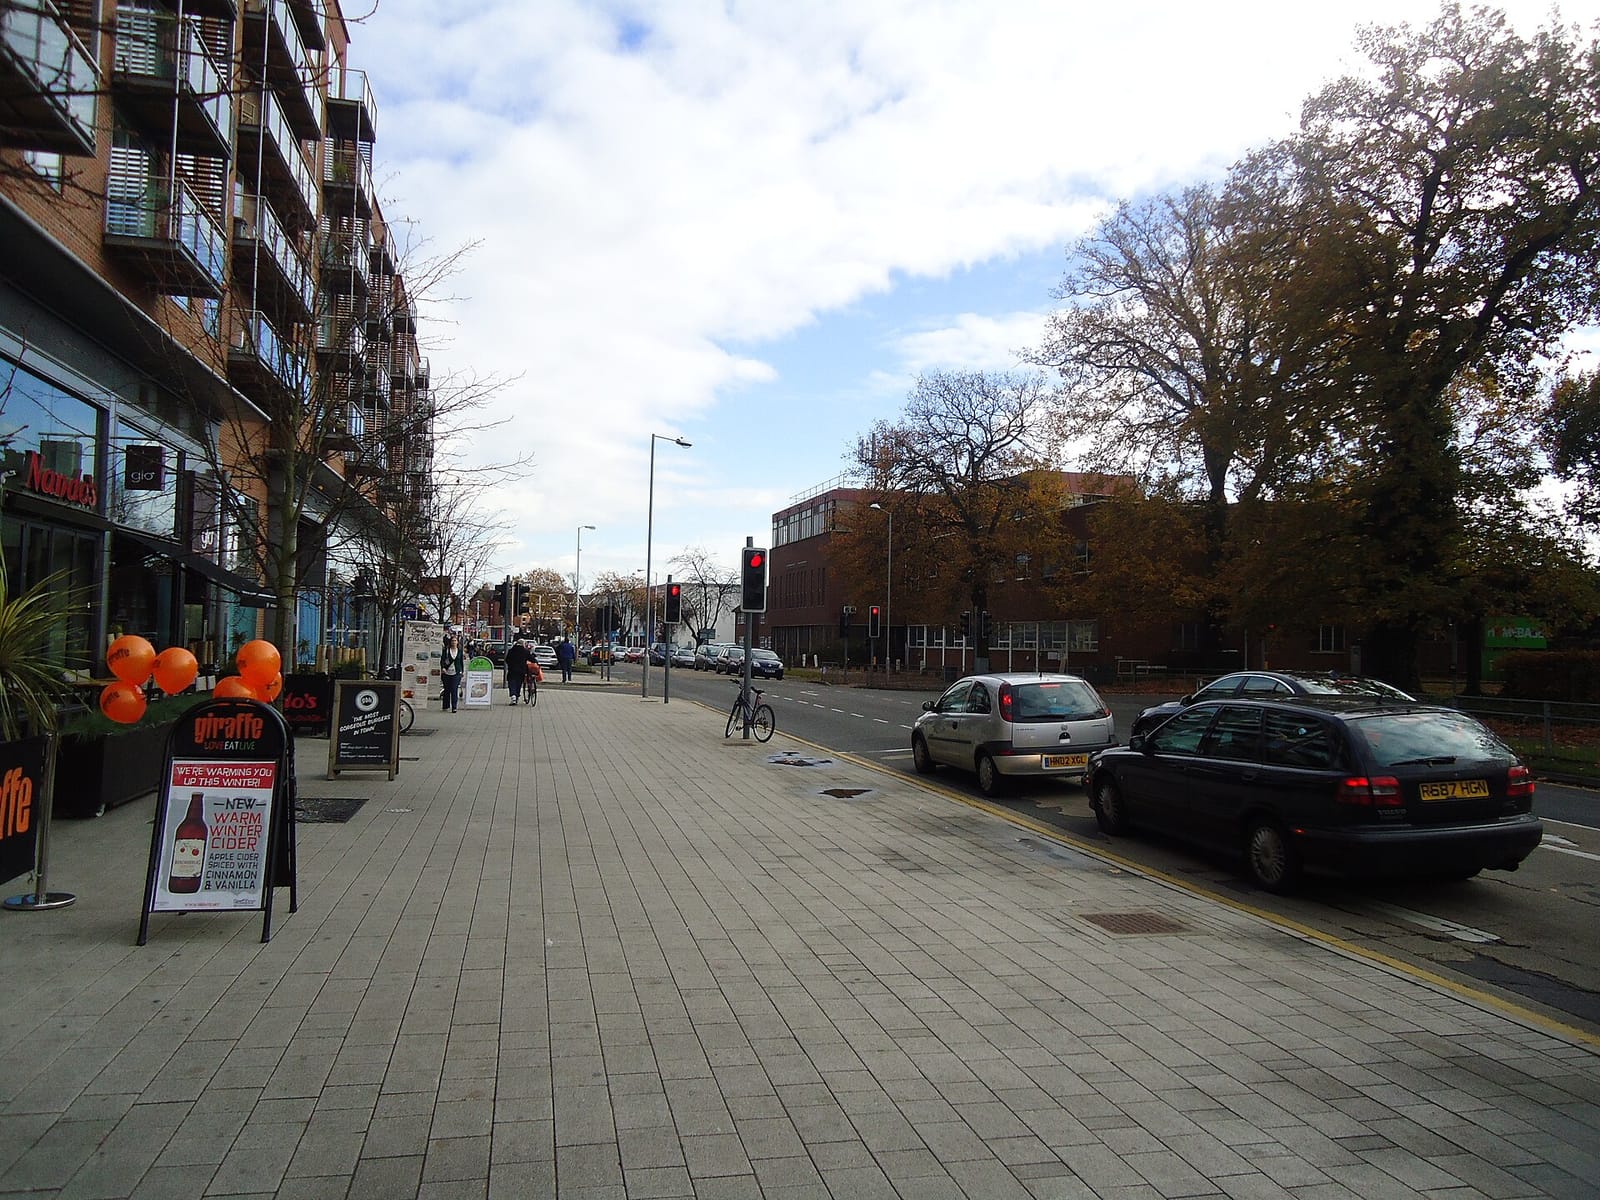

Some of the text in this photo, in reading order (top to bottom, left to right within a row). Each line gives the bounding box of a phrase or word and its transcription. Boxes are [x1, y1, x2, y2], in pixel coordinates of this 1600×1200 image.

[1487, 627, 1545, 638] HMEBA
[194, 712, 264, 743] giraffe
[1049, 755, 1086, 767] HN02 XGL
[176, 766, 272, 777] WE'RE WARMING YOU
[183, 777, 261, 787] UP THIS WINTER!
[1421, 780, 1487, 798] R687 HGN
[0, 767, 32, 840] ffe
[226, 798, 256, 810] NEW
[214, 812, 261, 824] WARM
[210, 825, 262, 838] WINTER
[211, 837, 258, 851] CIDER
[209, 853, 259, 861] APPLE CIDER
[208, 861, 235, 869] SPICED
[206, 870, 258, 879] CINNAMON
[204, 880, 256, 890] & VANILLA
